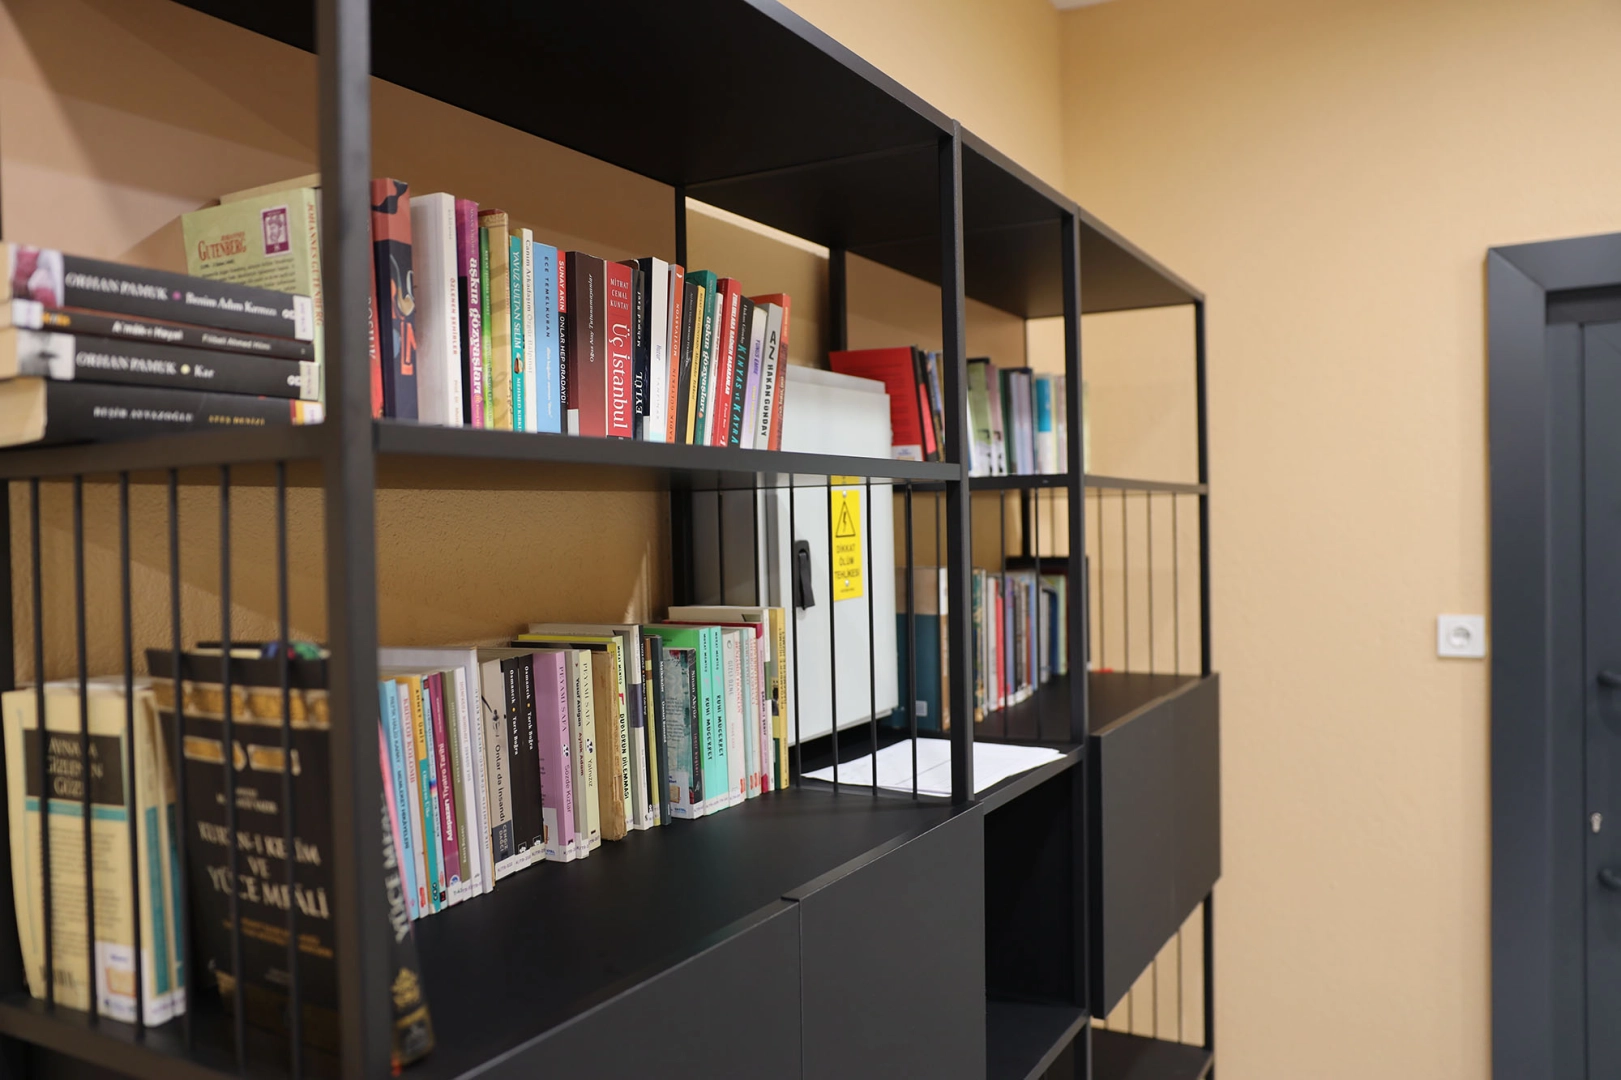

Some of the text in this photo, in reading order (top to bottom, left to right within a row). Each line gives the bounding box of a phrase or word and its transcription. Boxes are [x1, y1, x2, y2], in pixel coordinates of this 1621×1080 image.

[198, 238, 247, 261] GUTENBERG
[65, 271, 118, 293] ORHAN
[119, 280, 168, 301] PAMUK
[469, 257, 480, 305] aşkın
[610, 277, 629, 289] MİTHAT
[611, 289, 628, 300] CEMAL
[610, 299, 629, 311] KUNTAY
[729, 293, 738, 330] ZORLUKLARA
[704, 315, 712, 349] aşkın
[76, 351, 214, 380] ORHAN PAMUK Kar
[468, 308, 483, 395] gözyaşları
[735, 344, 746, 389] KİNYAS
[609, 323, 631, 428] Üç İstanbul
[635, 371, 643, 414] EYLÜL
[699, 351, 710, 413] gözyaşları
[725, 355, 734, 394] BAŞARANLAR
[761, 330, 776, 437] AZ HAKAN GÜNDAY
[731, 403, 742, 443] KAYRA
[836, 543, 856, 553] DİKKAT
[438, 743, 446, 767] Tarihi
[495, 744, 503, 772] Onlar
[497, 773, 503, 786] da
[621, 756, 629, 800] DİLEMMASI
[445, 799, 454, 841] Adapazarı
